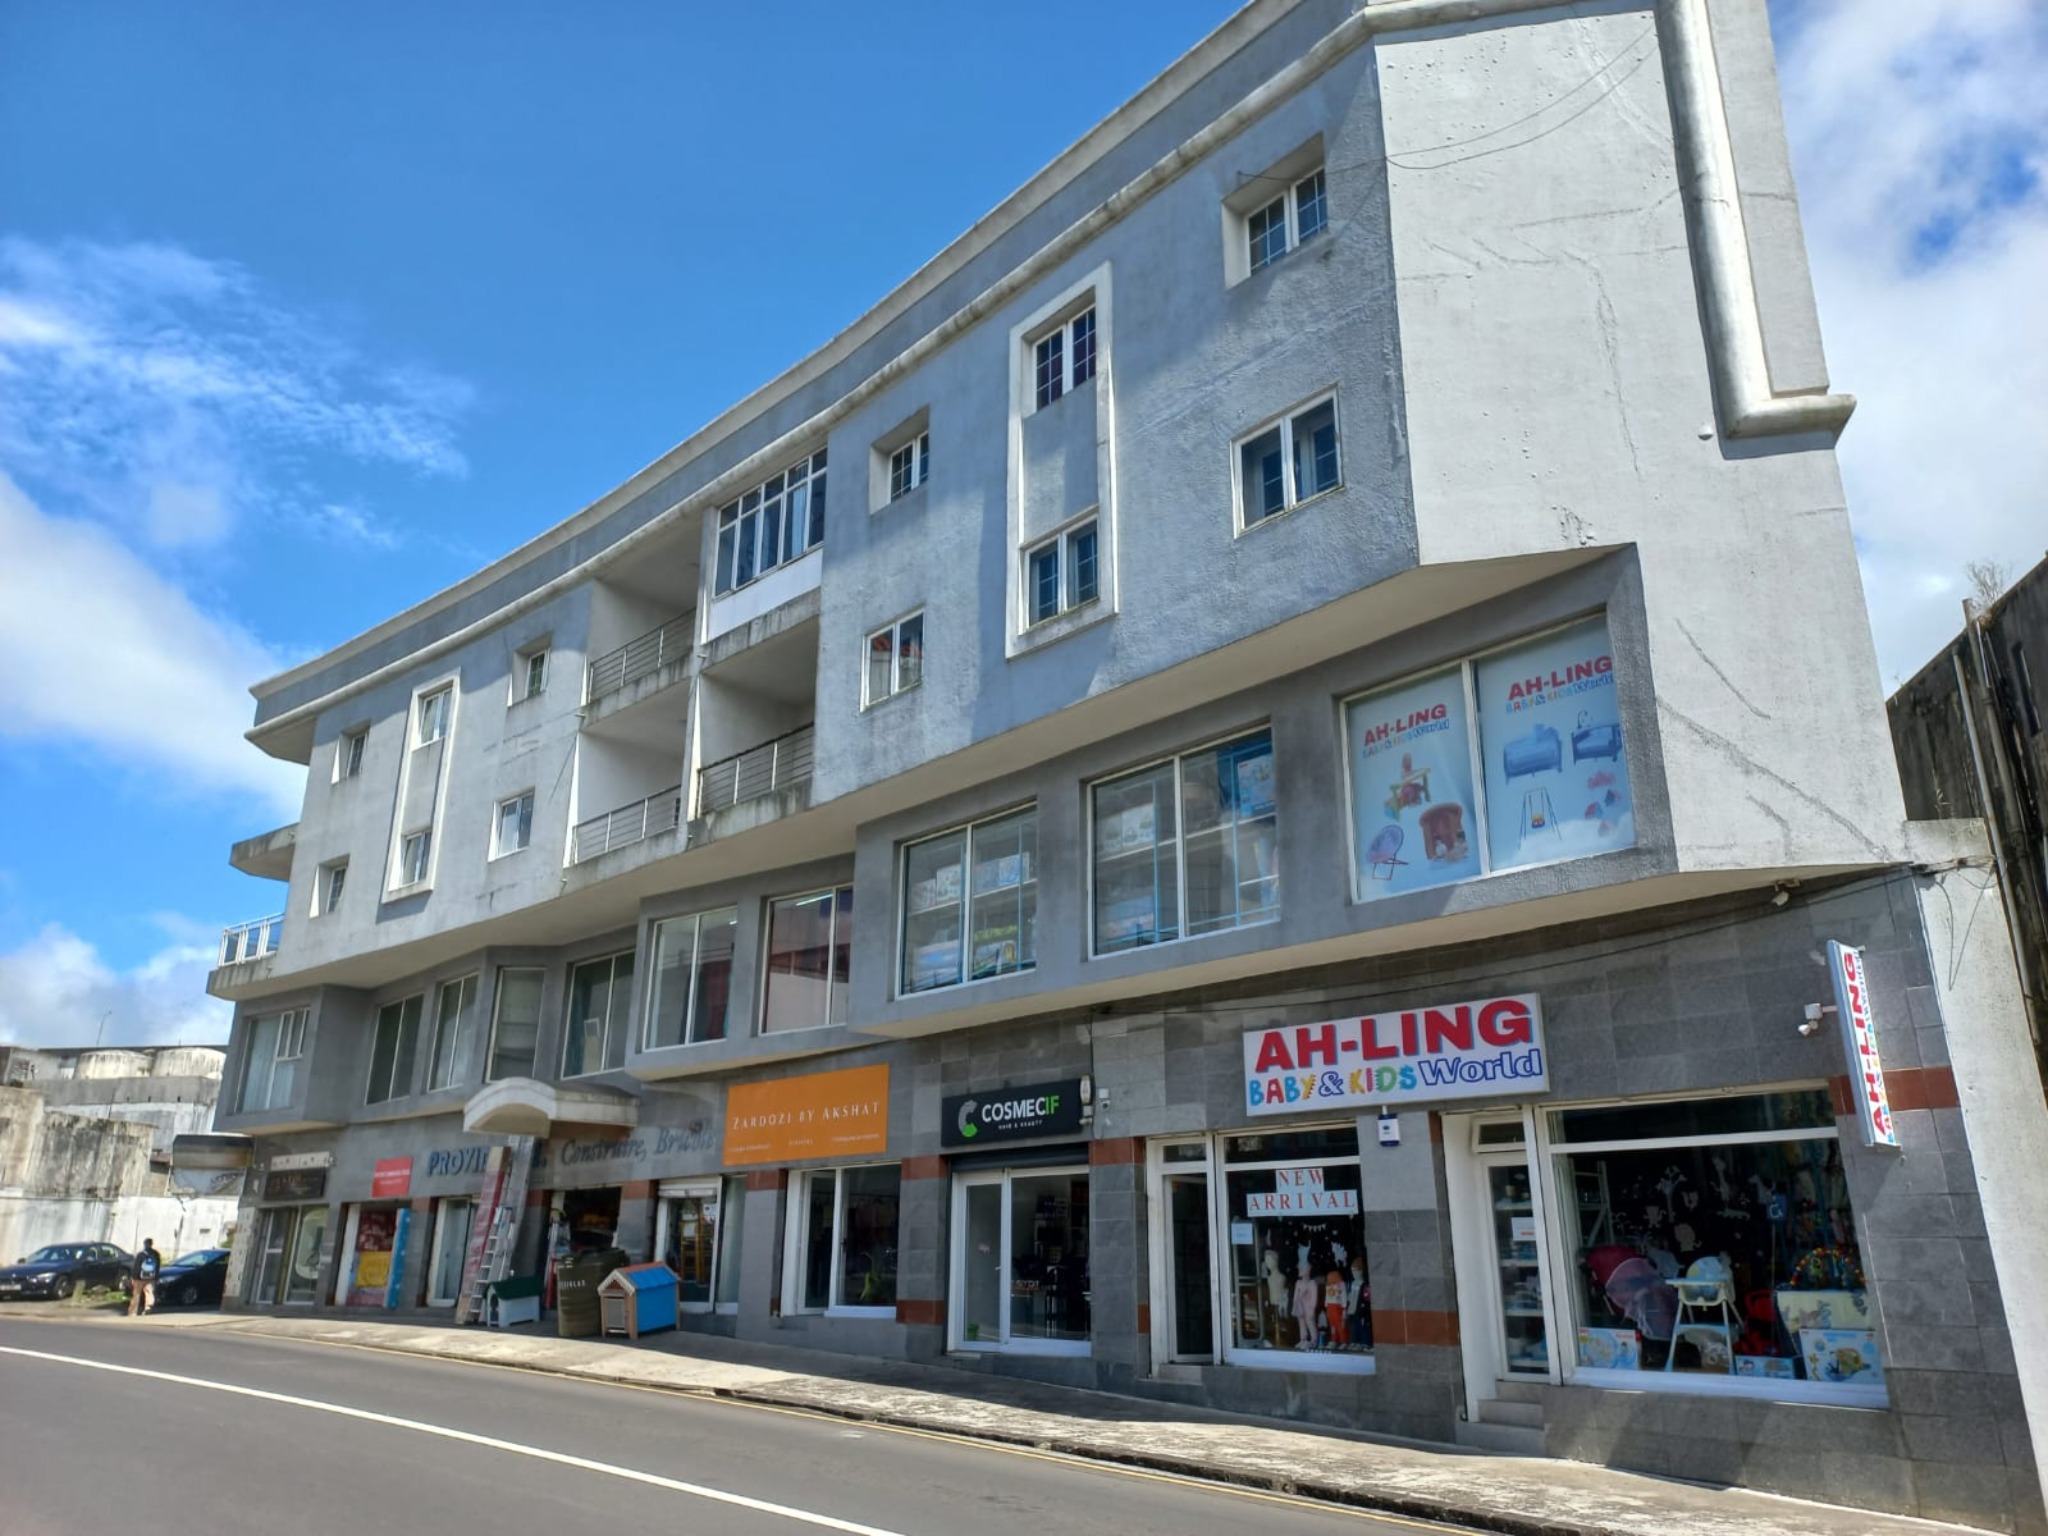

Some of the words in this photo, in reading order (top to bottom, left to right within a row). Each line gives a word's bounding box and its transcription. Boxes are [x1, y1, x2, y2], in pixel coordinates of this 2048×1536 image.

[1508, 656, 1612, 701] AH-LING
[1364, 703, 1447, 747] AH-LING
[1255, 998, 1534, 1073] AH-LING
[1844, 952, 1887, 1136] AH-LING
[1249, 1073, 1317, 1107] BABY
[1317, 1071, 1345, 1098] &
[1349, 1065, 1418, 1095] KIDS
[1417, 1048, 1543, 1087] World
[732, 1111, 791, 1131] ZARDOZI
[799, 1109, 815, 1123] BY
[822, 1101, 880, 1121] AKSHAT
[981, 1095, 1060, 1123] COSMECIF
[1279, 1169, 1324, 1187] NEW
[1249, 1191, 1355, 1211] ARRIVAL
